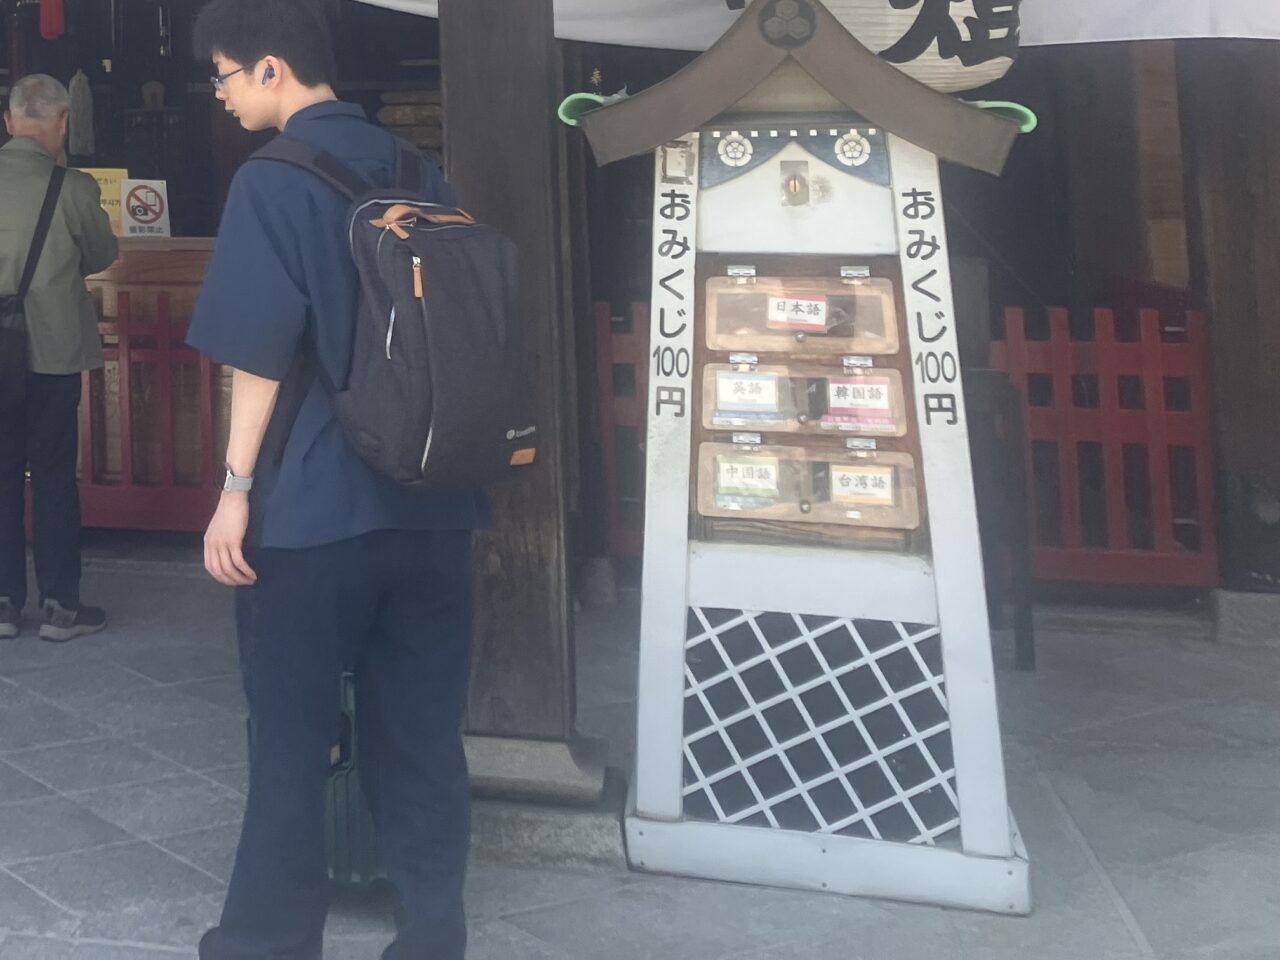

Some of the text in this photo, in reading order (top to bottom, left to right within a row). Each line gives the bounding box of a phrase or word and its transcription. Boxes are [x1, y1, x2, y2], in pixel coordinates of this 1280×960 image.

[652, 188, 691, 419] おみくじ100円
[776, 300, 822, 317] 日本語
[901, 187, 958, 426] おみくじ100円
[833, 385, 884, 400] 韓国語
[726, 465, 771, 480] 中国語
[838, 473, 887, 489] 台湾語
